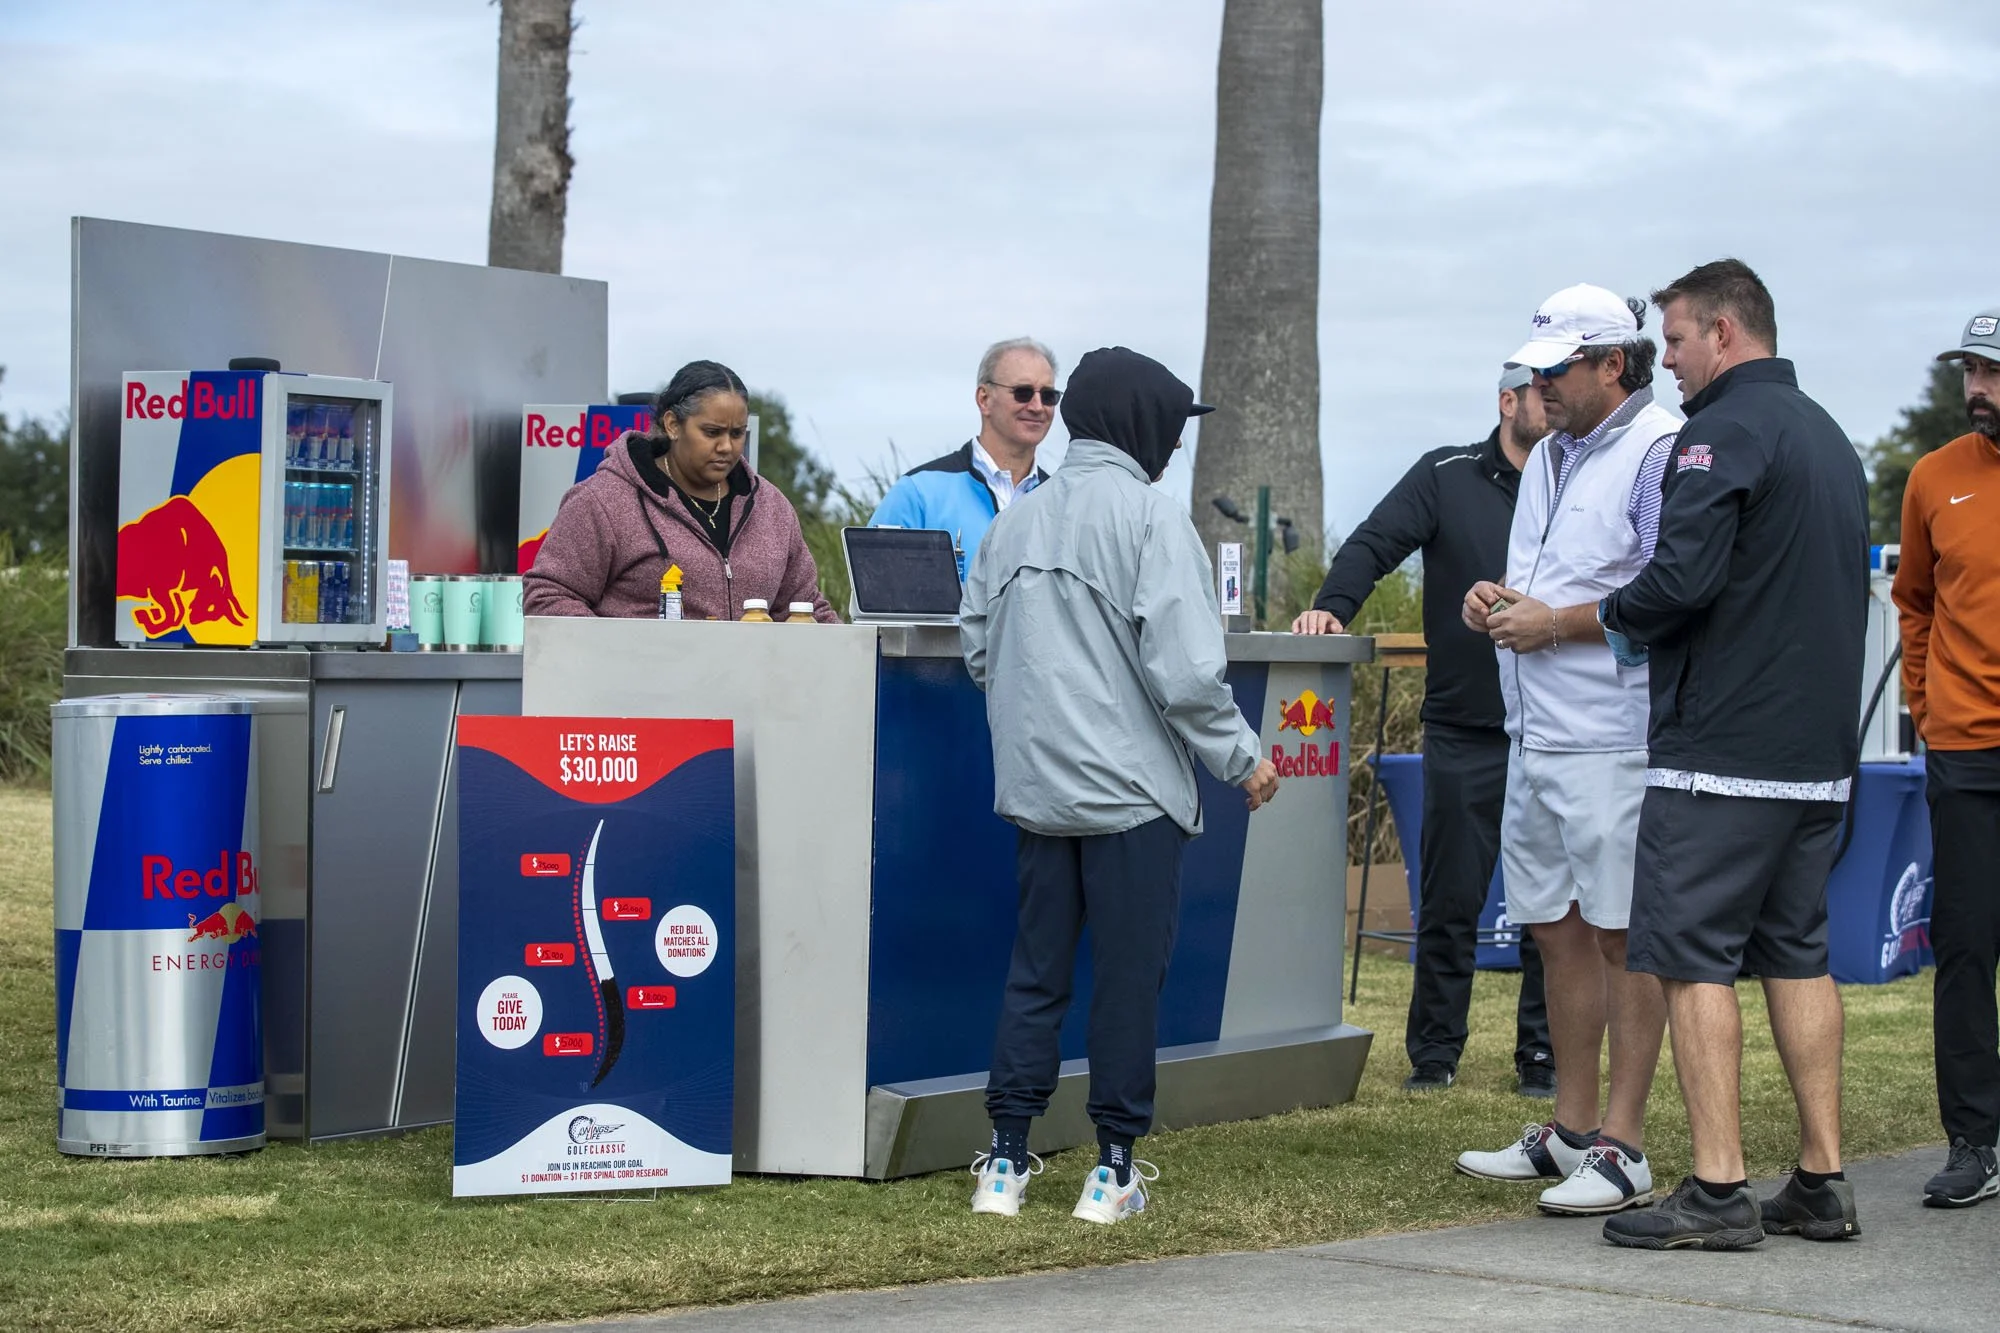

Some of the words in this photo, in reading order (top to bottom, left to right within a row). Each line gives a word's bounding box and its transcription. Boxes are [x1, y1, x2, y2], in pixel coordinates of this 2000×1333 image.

[126, 379, 188, 420] Red
[193, 378, 256, 419] Bull
[526, 412, 586, 448] Red
[139, 744, 164, 756] Lightly
[167, 743, 213, 754] carbonated.
[559, 733, 595, 752] LET'S
[598, 733, 637, 752] RAISE
[139, 755, 162, 765] Serve
[165, 754, 193, 765] chilled.
[1271, 742, 1306, 777] Red
[1307, 741, 1340, 777] Bull
[559, 753, 638, 786] $30,000
[142, 849, 229, 900] Red
[236, 851, 261, 896] Bu
[670, 925, 685, 935] RED
[686, 925, 704, 935] BULL
[663, 936, 696, 947] MATCHES
[697, 936, 710, 946] ALL
[667, 947, 706, 958] DONATIONS
[152, 952, 237, 972] ENERGY
[497, 1000, 523, 1015] GIVE
[492, 1016, 528, 1031] TODAY
[128, 1093, 158, 1108] With
[160, 1093, 203, 1107] Taurine.
[208, 1090, 246, 1105] Vitalizes
[1110, 1143, 1124, 1166] NIKE
[547, 1162, 561, 1172] JOIN
[562, 1162, 571, 1171] US
[572, 1161, 579, 1170] IN
[580, 1160, 612, 1170] REACHING
[613, 1159, 626, 1169] OUR
[627, 1158, 644, 1168] GOAL
[521, 1174, 529, 1183] $1
[531, 1172, 562, 1183] DONATION
[570, 1172, 578, 1181] $1
[579, 1170, 593, 1180] FOR
[593, 1169, 616, 1180] SPINAL
[617, 1168, 635, 1179] CORD
[635, 1167, 669, 1178] RESEARCH
